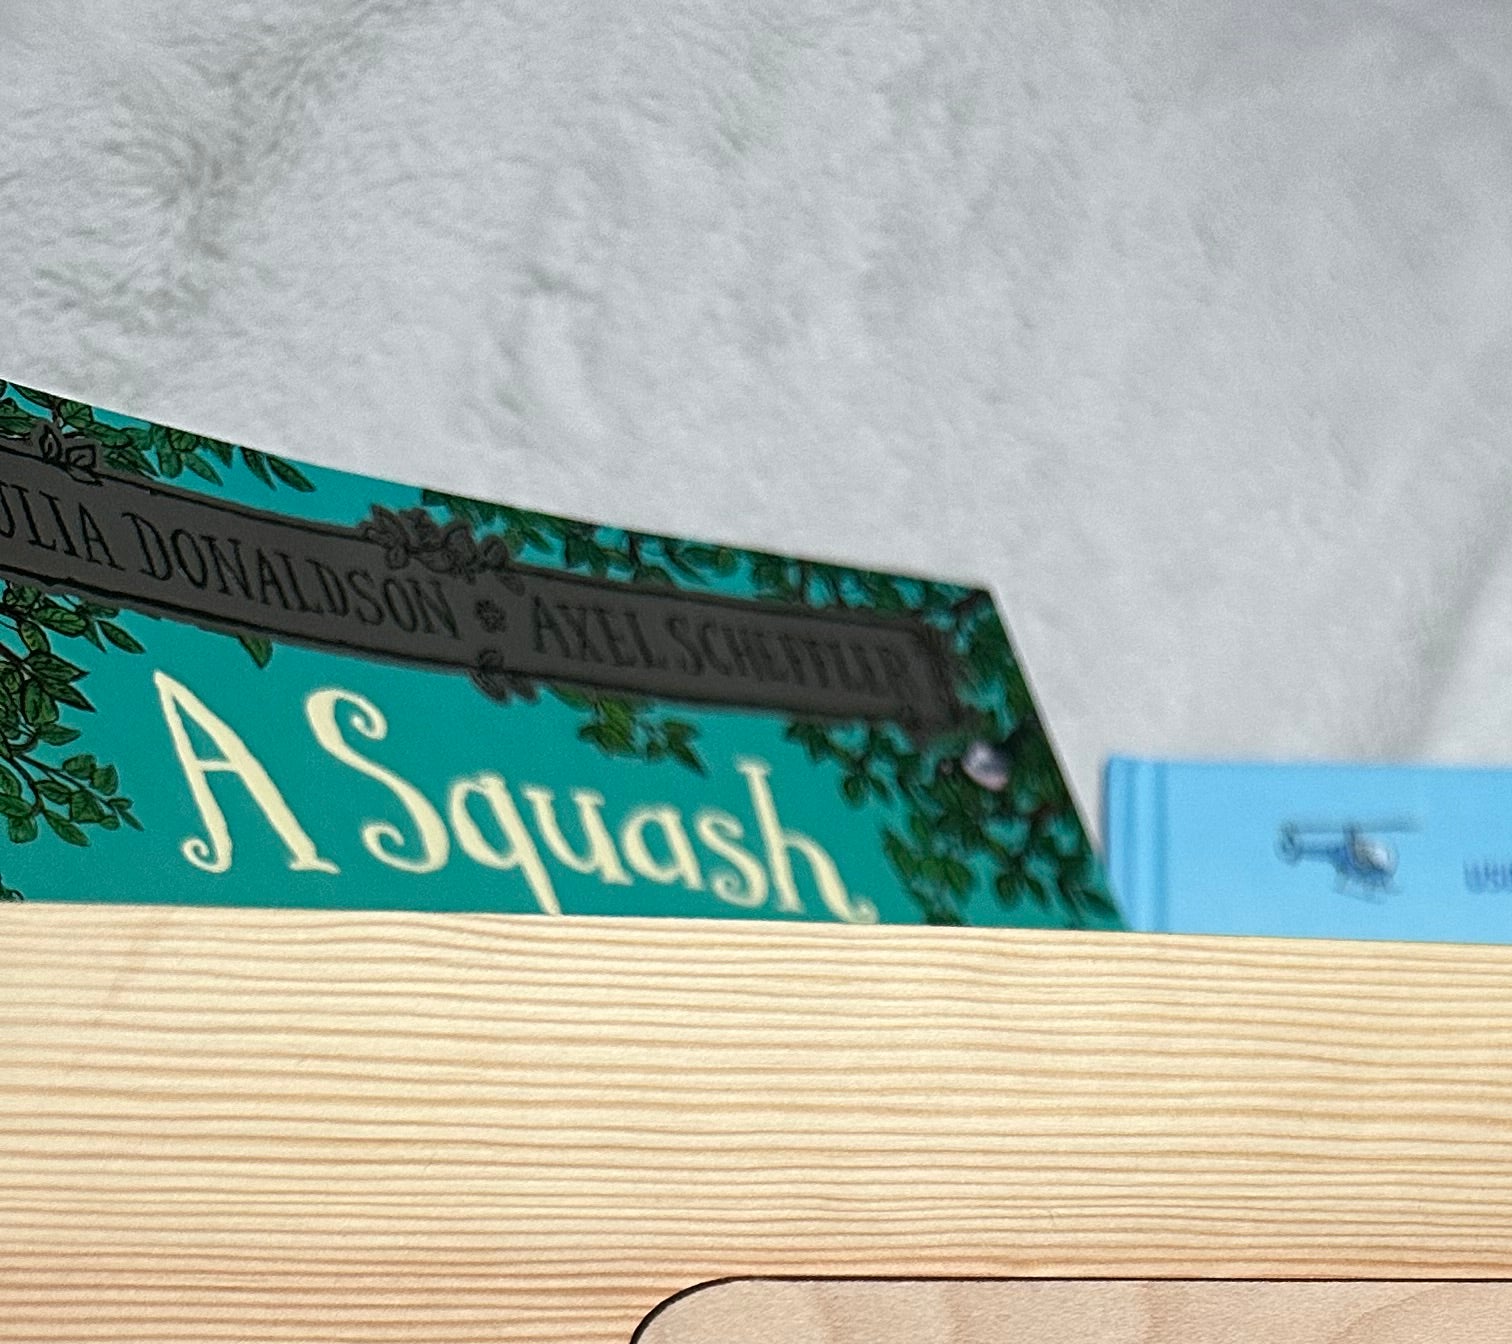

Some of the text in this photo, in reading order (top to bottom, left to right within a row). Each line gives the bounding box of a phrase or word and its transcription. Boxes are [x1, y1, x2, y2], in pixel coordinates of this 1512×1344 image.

[121, 511, 462, 640] DONALDSON
[532, 596, 666, 670] AXEL
[153, 669, 880, 924] A Squash
